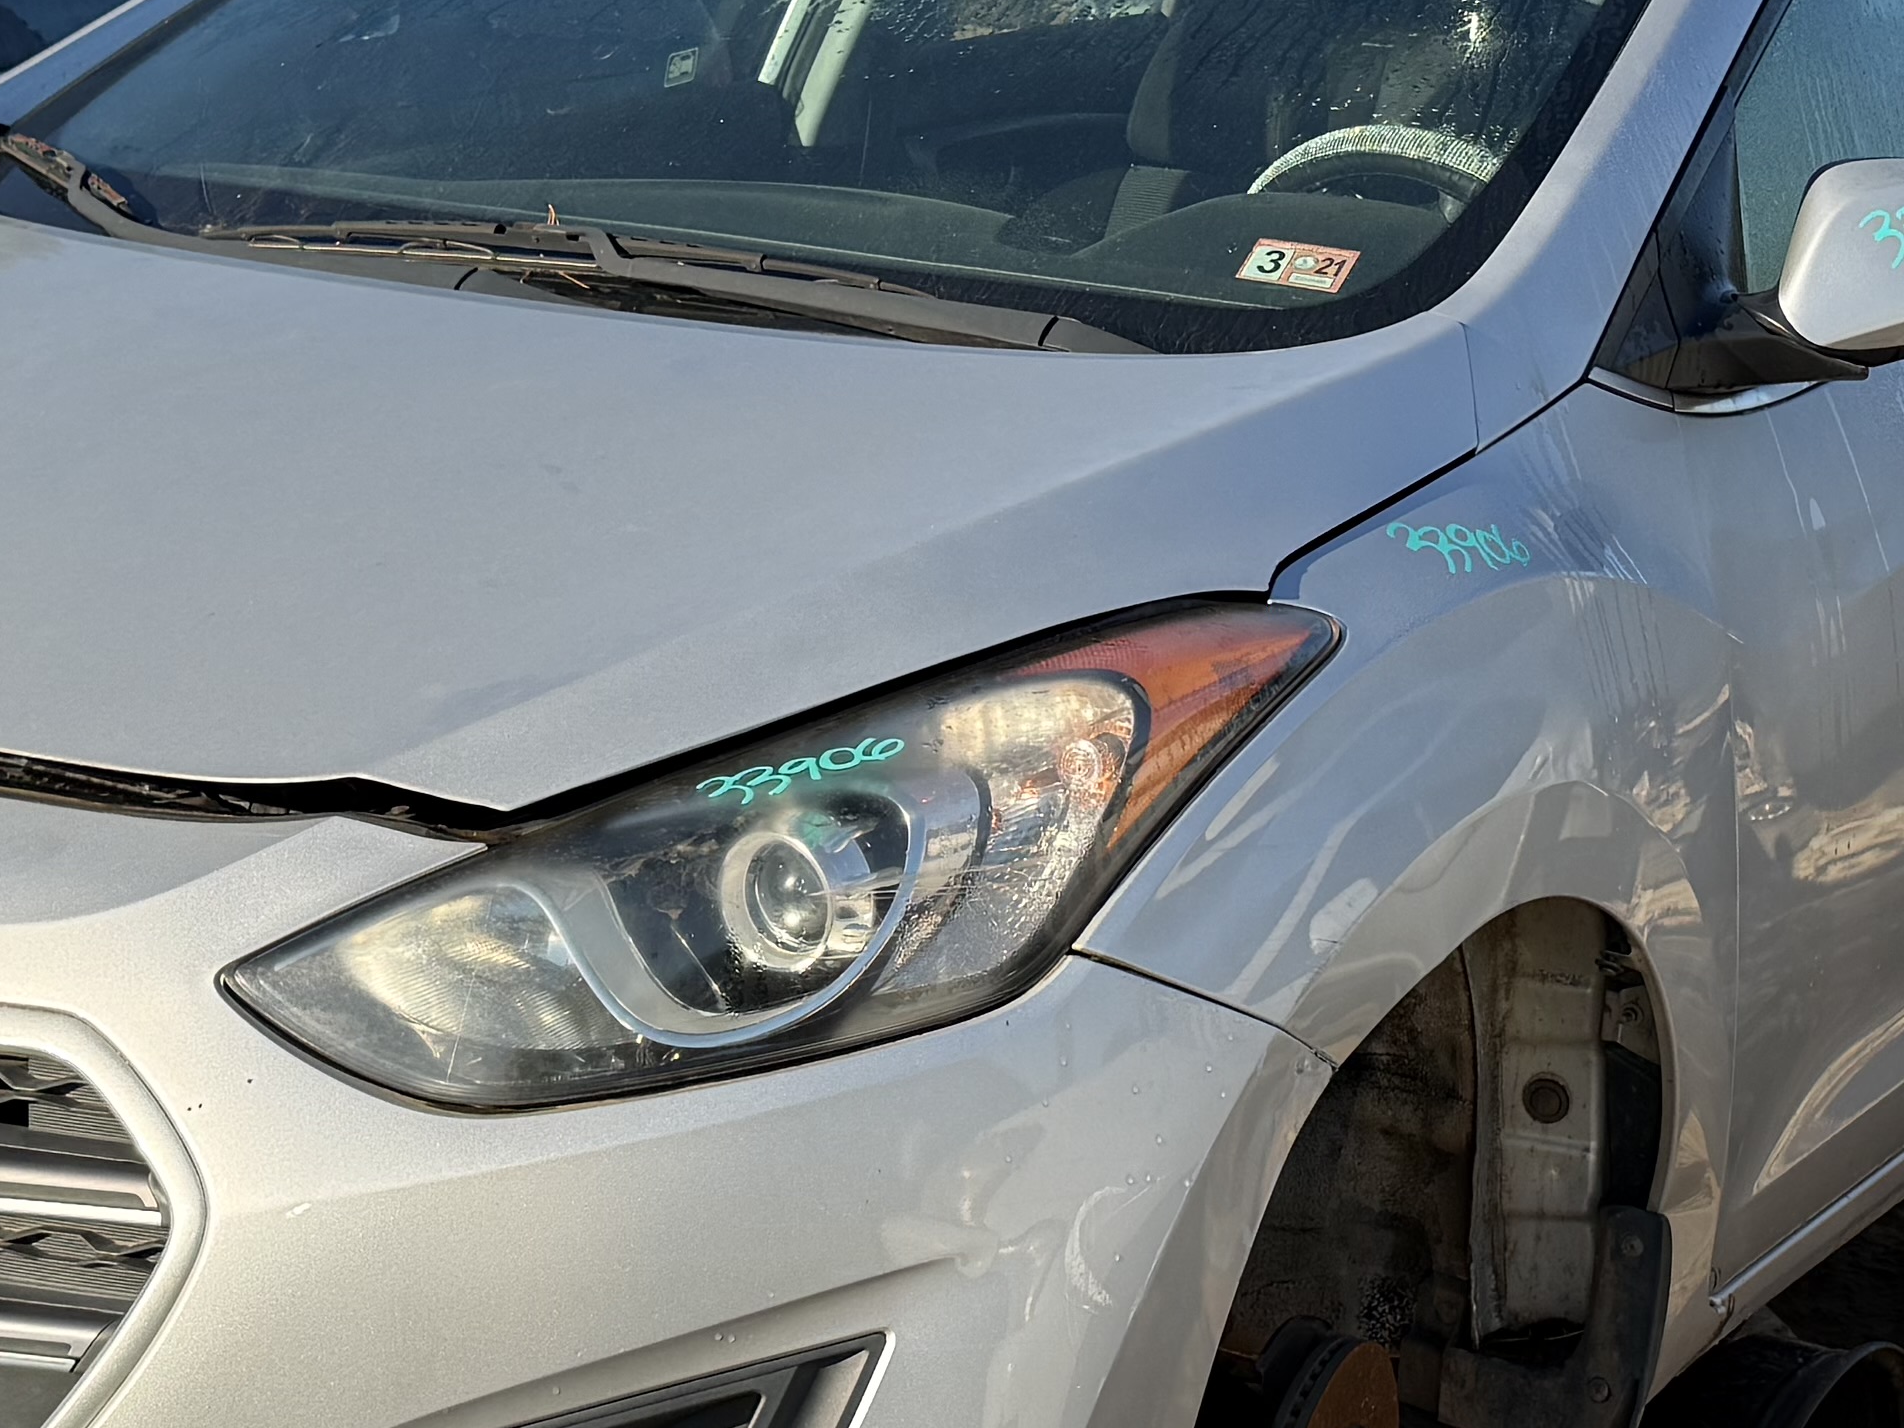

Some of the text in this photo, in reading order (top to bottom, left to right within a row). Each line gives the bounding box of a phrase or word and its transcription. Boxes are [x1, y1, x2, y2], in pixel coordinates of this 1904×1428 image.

[1257, 250, 1286, 274] 3
[1314, 258, 1347, 276] 21
[1386, 522, 1531, 574] 33906
[696, 738, 905, 805] 33906
